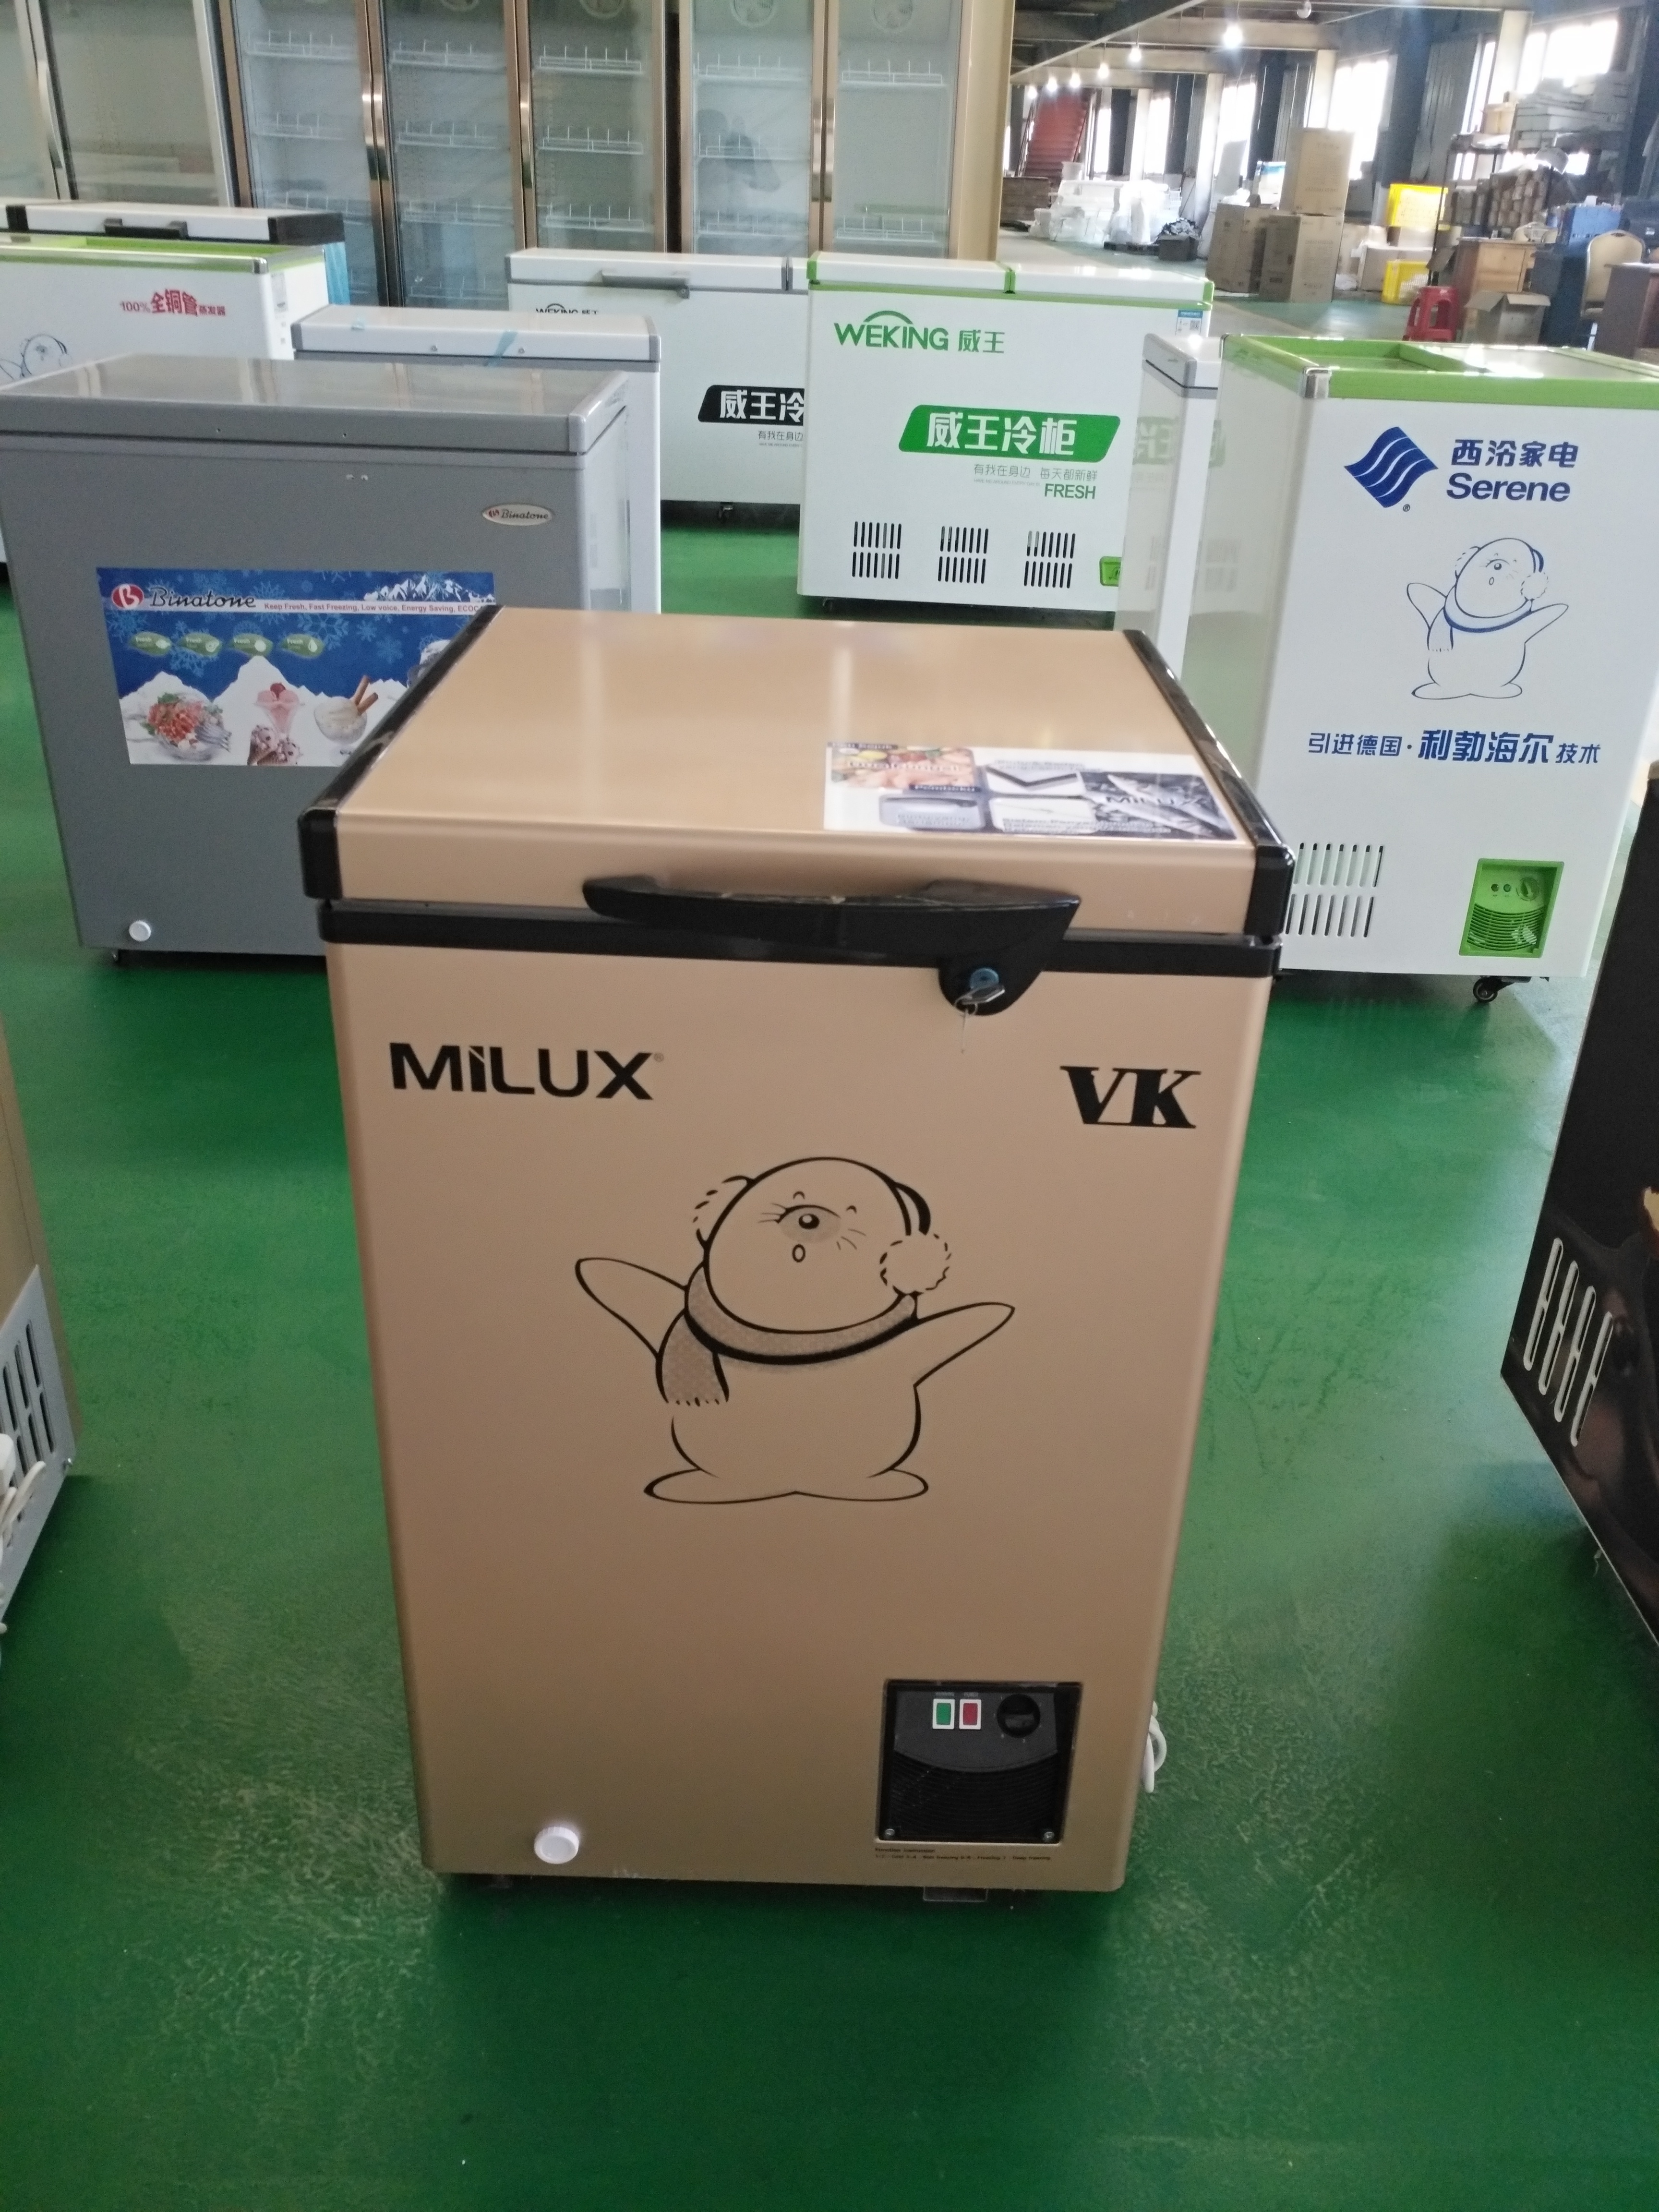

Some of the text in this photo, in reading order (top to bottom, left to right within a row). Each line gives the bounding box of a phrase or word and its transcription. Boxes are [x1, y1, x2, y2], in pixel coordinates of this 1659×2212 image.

[833, 322, 1005, 354] WEKING 威王
[926, 411, 1077, 455] 威王冷柜
[974, 463, 1098, 481] 有我在身边 每天都新鲜
[1044, 483, 1096, 500] FRESH
[1446, 472, 1571, 502] Serene
[502, 509, 549, 519] Binatone
[149, 587, 256, 608] Binatone
[1059, 1065, 1201, 1129] VK
